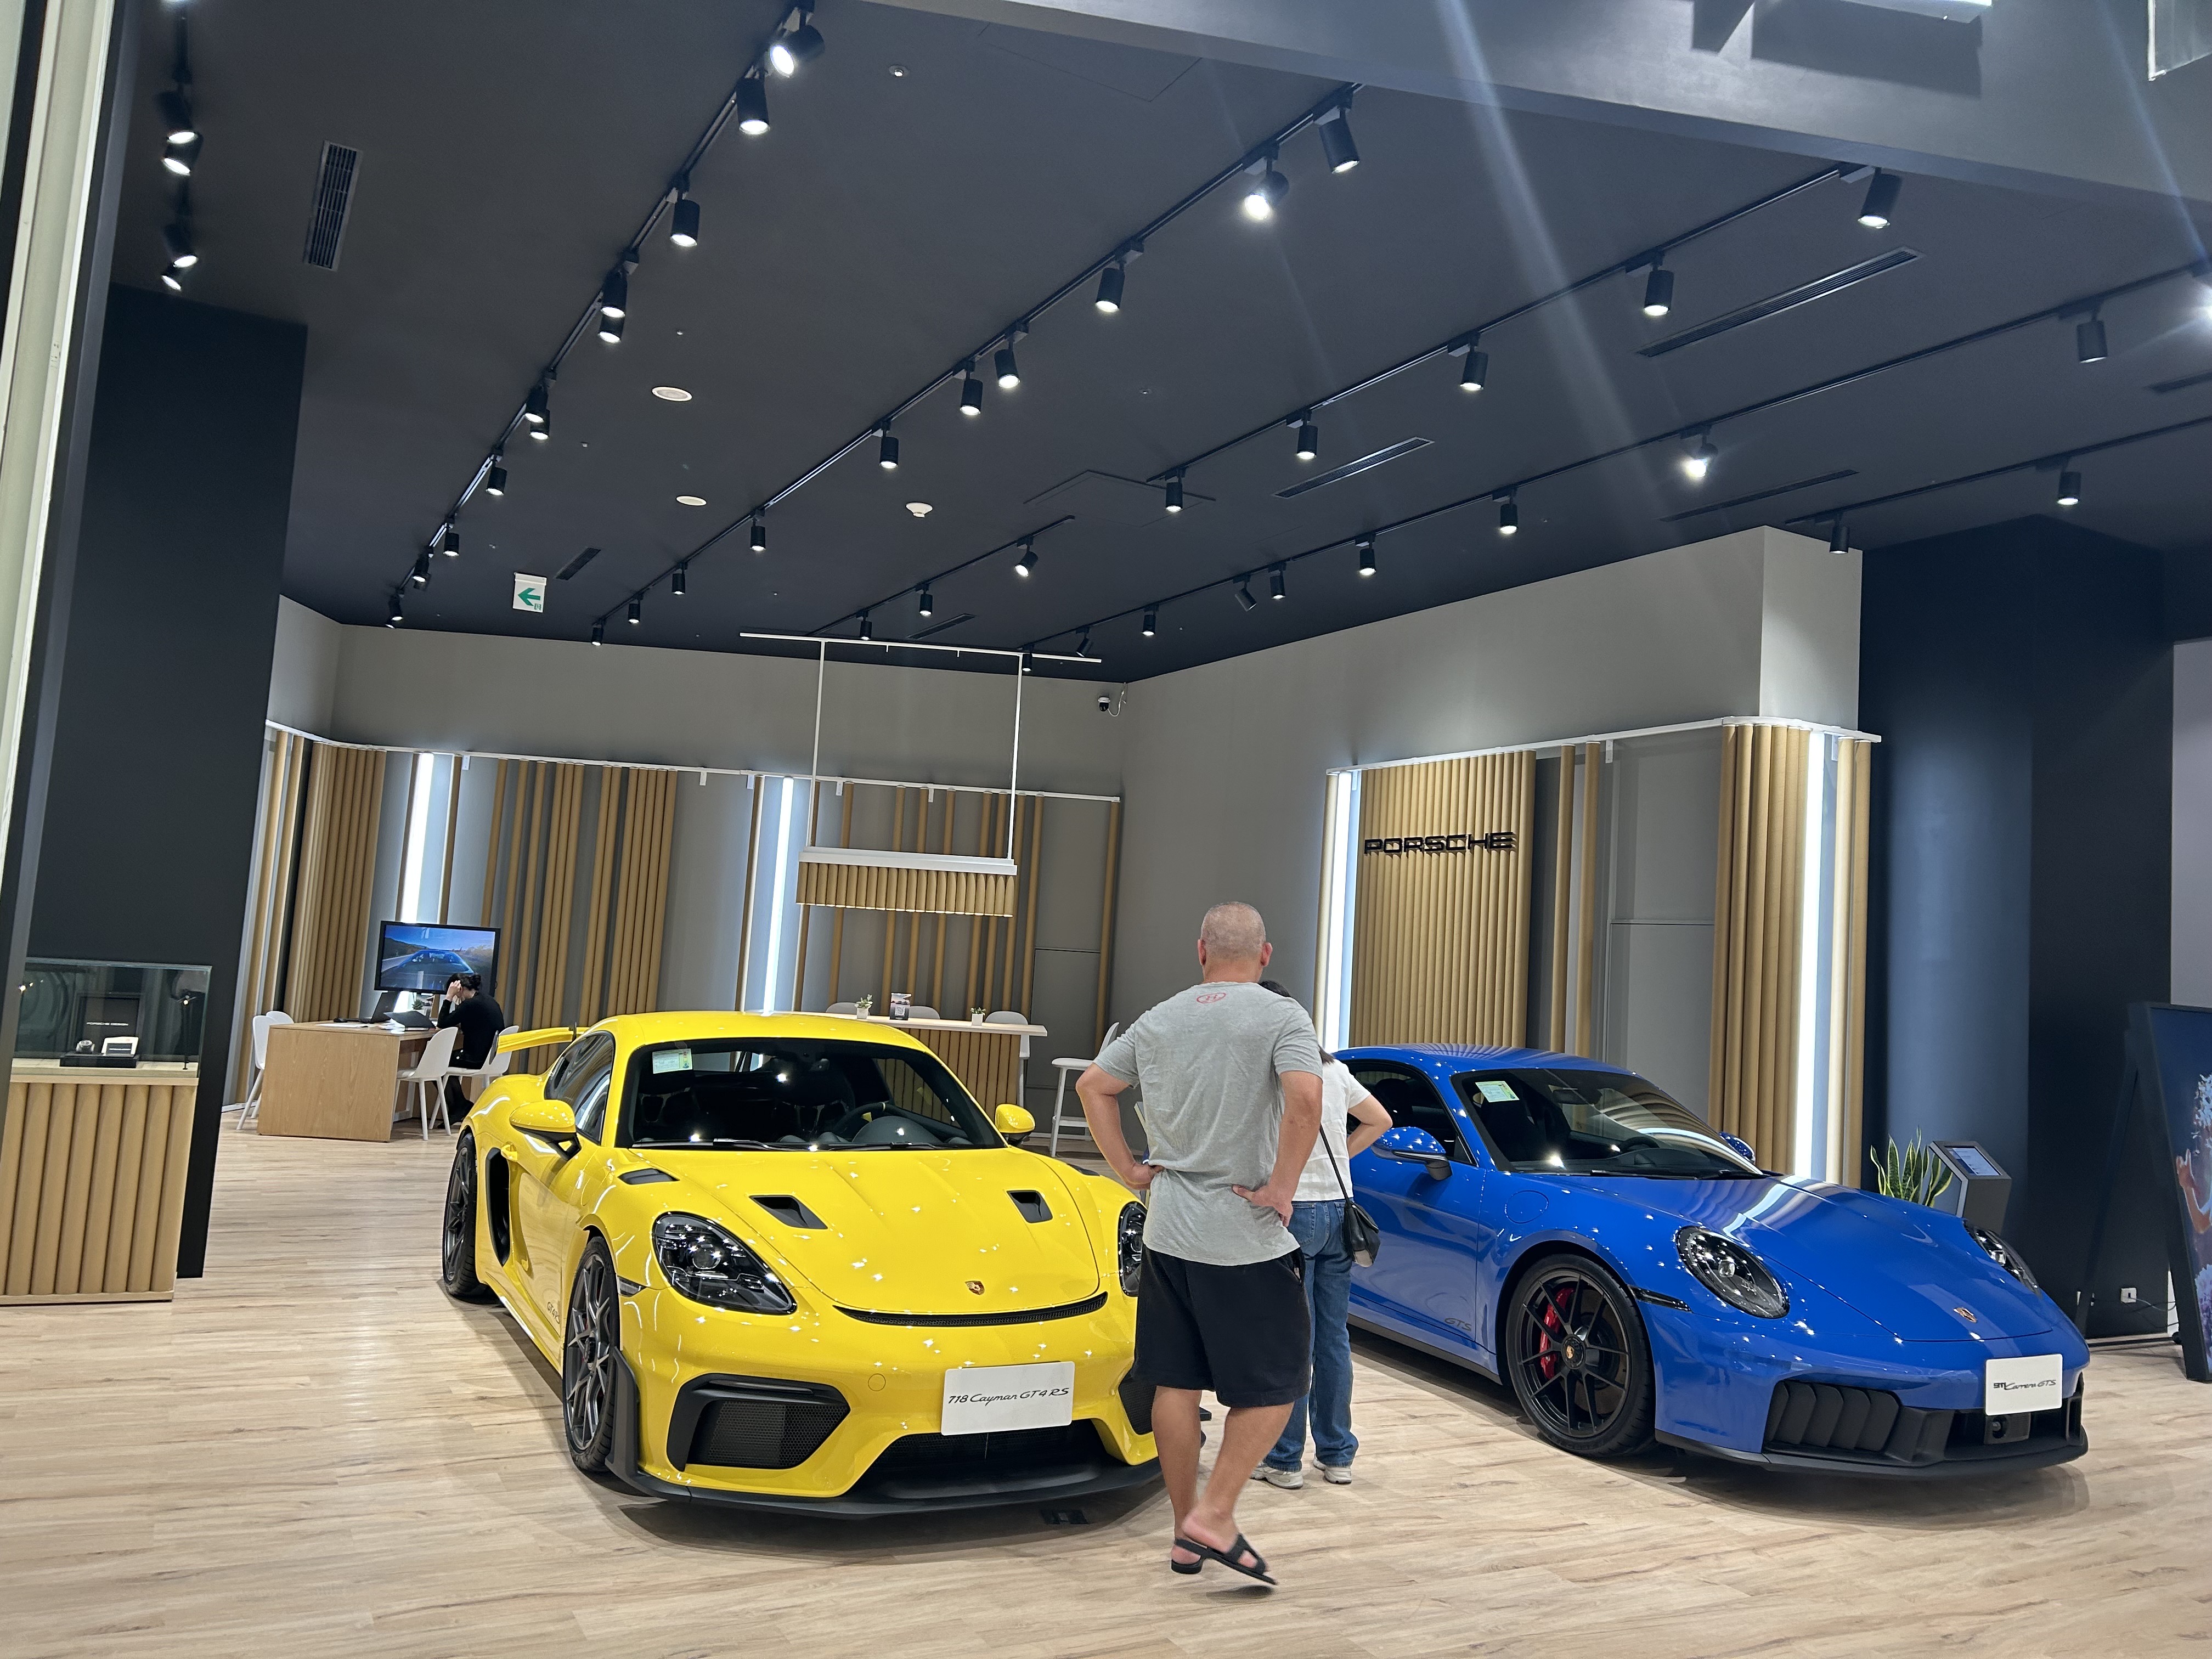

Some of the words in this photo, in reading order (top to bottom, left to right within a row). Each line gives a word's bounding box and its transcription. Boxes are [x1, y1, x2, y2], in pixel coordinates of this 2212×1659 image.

[1364, 831, 1514, 854] PORSCHE
[1444, 1318, 1472, 1331] GTS
[2037, 1379, 2057, 1387] GTS
[948, 1395, 969, 1404] 718
[969, 1393, 1017, 1406] Cayman
